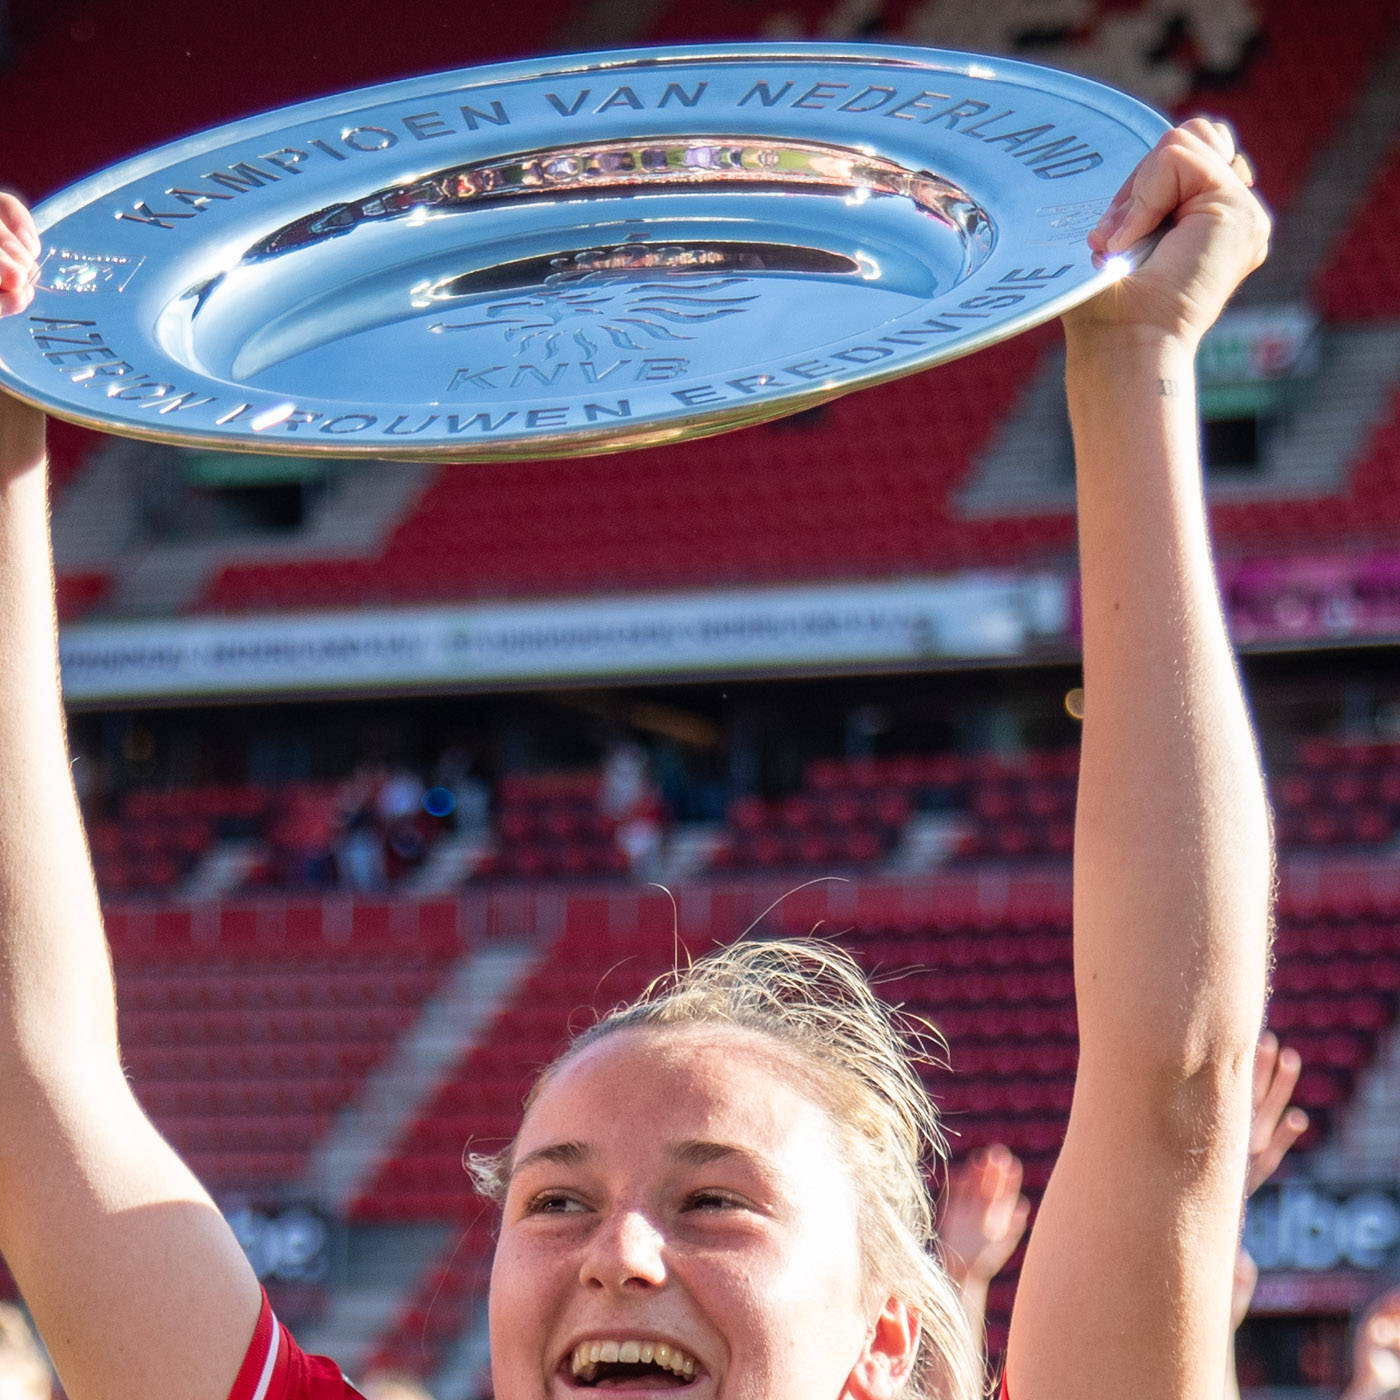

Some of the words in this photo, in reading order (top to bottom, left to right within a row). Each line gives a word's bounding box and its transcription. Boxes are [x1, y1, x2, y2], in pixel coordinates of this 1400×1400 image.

[114, 100, 511, 229] KAMPIOEN
[545, 81, 708, 117] VAN
[738, 80, 1105, 181] NEDERLAND
[28, 316, 218, 415] AZERION
[215, 400, 632, 436] VROUWEN
[671, 263, 1075, 408] EREDIVISIE
[446, 357, 691, 392] KNVB
